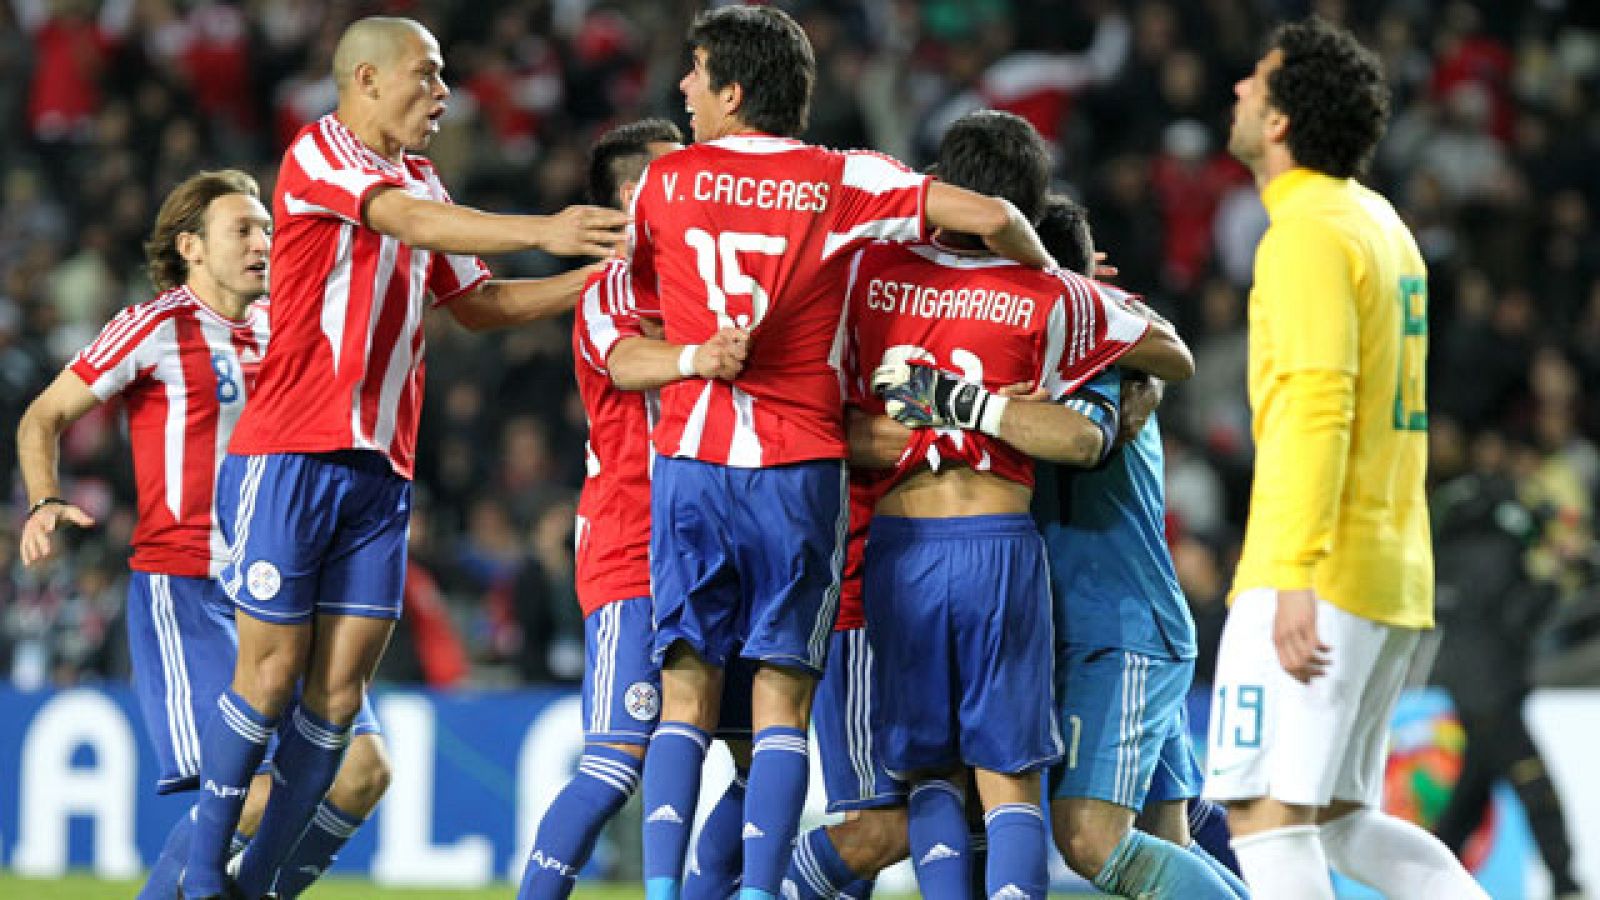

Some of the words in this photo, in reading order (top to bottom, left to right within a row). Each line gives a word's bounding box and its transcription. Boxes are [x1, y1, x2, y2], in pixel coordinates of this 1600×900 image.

[693, 169, 832, 214] CACERES
[684, 226, 788, 331] 15
[866, 278, 1036, 330] ESTIGARRIBIA
[211, 352, 239, 405] 8
[1068, 714, 1082, 769] 1
[1216, 684, 1264, 749] 19
